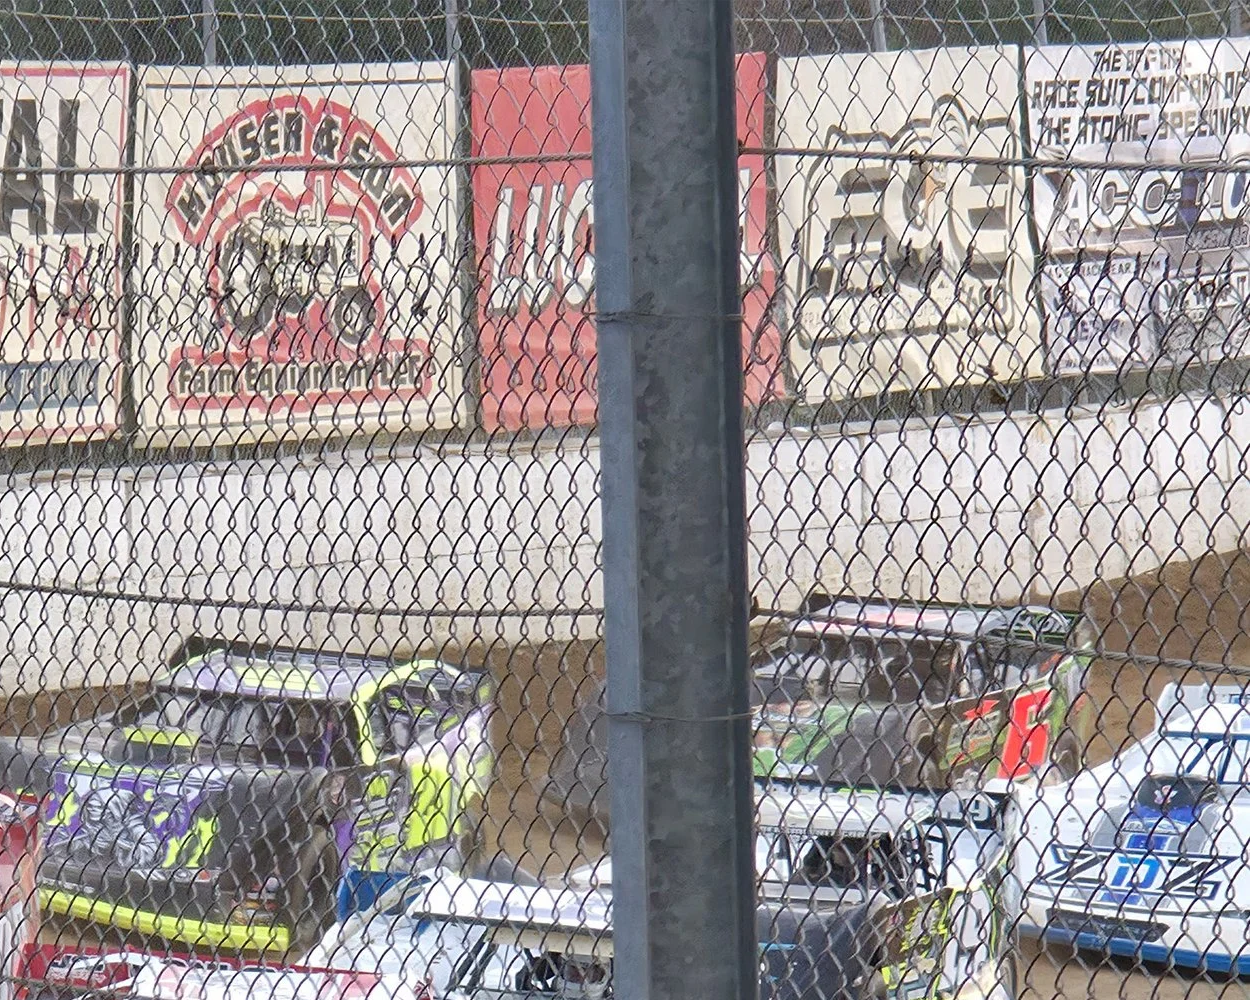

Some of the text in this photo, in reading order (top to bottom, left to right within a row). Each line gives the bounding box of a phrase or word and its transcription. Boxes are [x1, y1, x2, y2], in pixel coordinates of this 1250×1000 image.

[1085, 77, 1131, 108] SUIT
[313, 115, 339, 160] &
[1037, 116, 1071, 146] THE
[1078, 112, 1151, 145] ATOMIC
[489, 180, 593, 307] LUC
